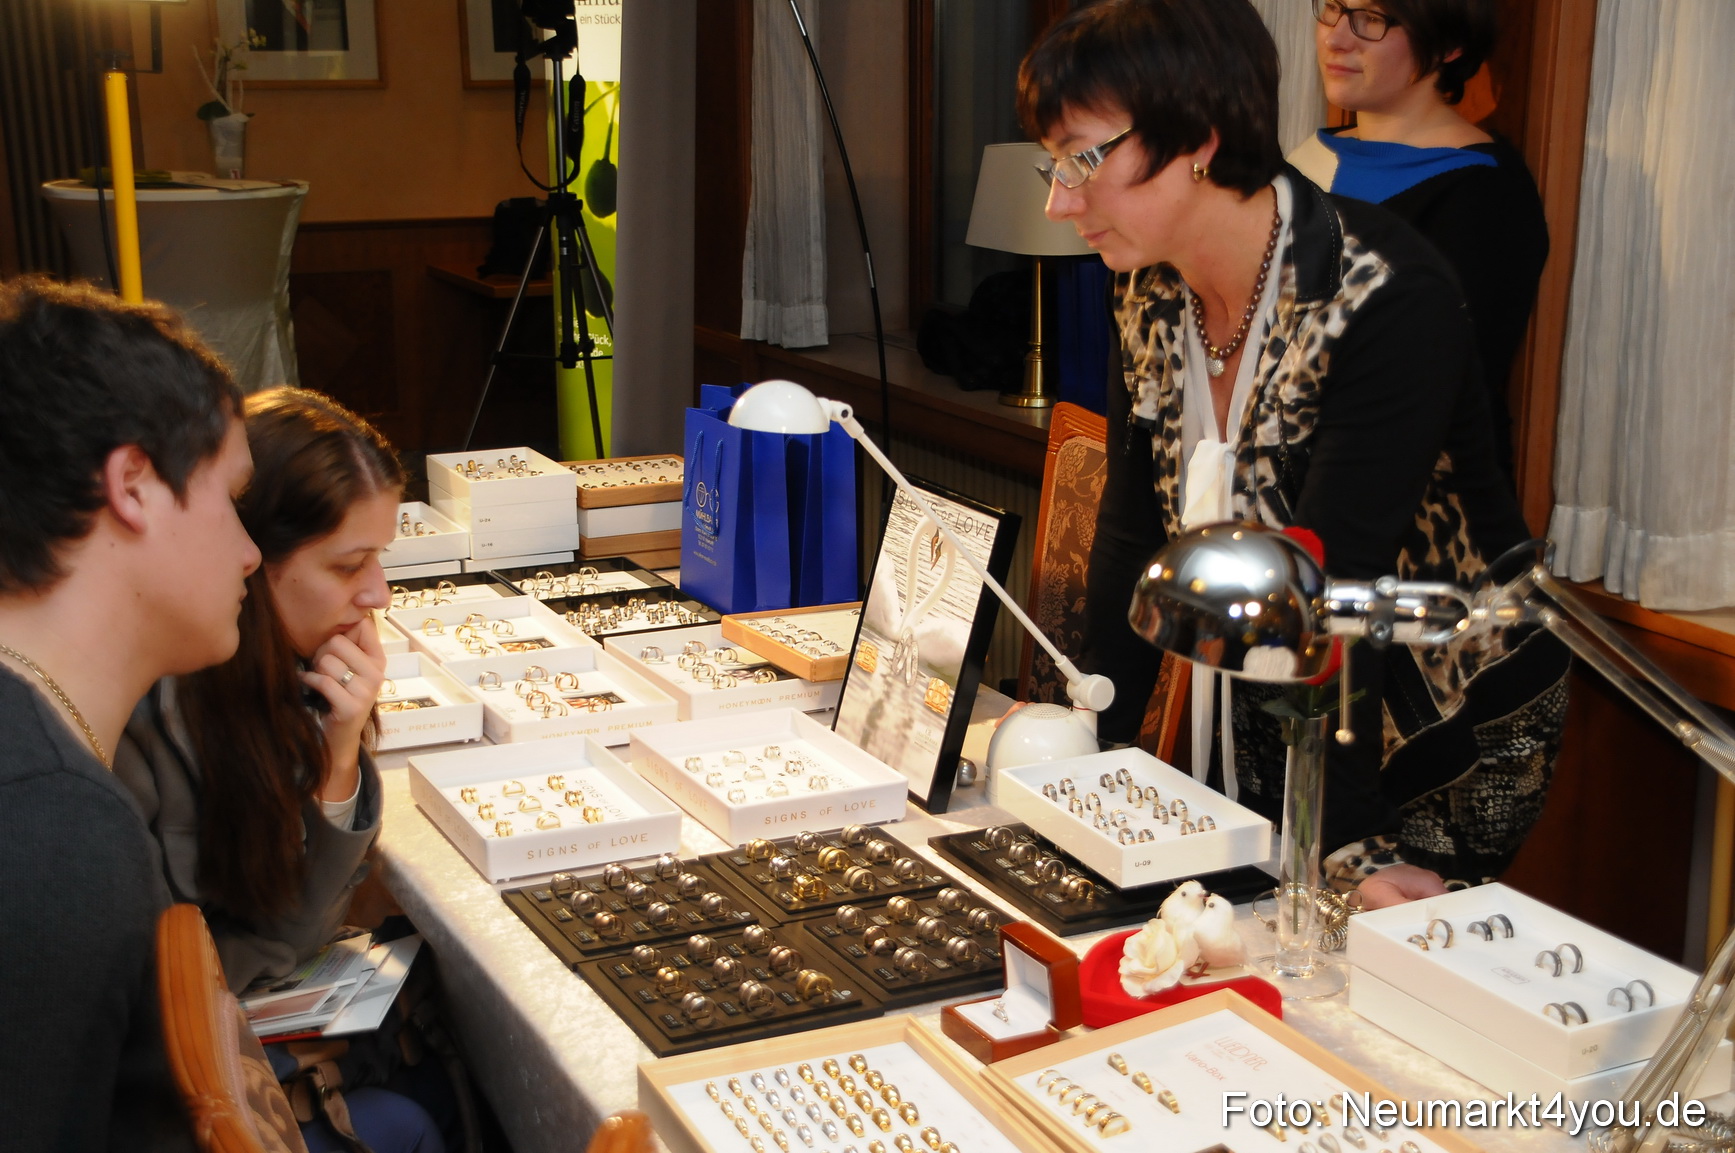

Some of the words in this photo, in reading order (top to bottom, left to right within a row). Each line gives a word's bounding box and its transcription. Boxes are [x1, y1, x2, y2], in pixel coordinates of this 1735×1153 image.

[580, 14, 593, 25] ein
[594, 14, 622, 25] Stück
[955, 512, 994, 542] LOVE
[779, 690, 821, 701] PREMIUM
[408, 720, 456, 732] PREMIUM
[607, 720, 653, 731] PREMIUM
[764, 810, 807, 825] SIGNS
[844, 799, 876, 812] LOVE
[527, 843, 578, 860] SIGNS
[611, 833, 648, 847] LOVE
[1134, 859, 1151, 868] U-09
[1185, 1050, 1226, 1081] Vario-Box
